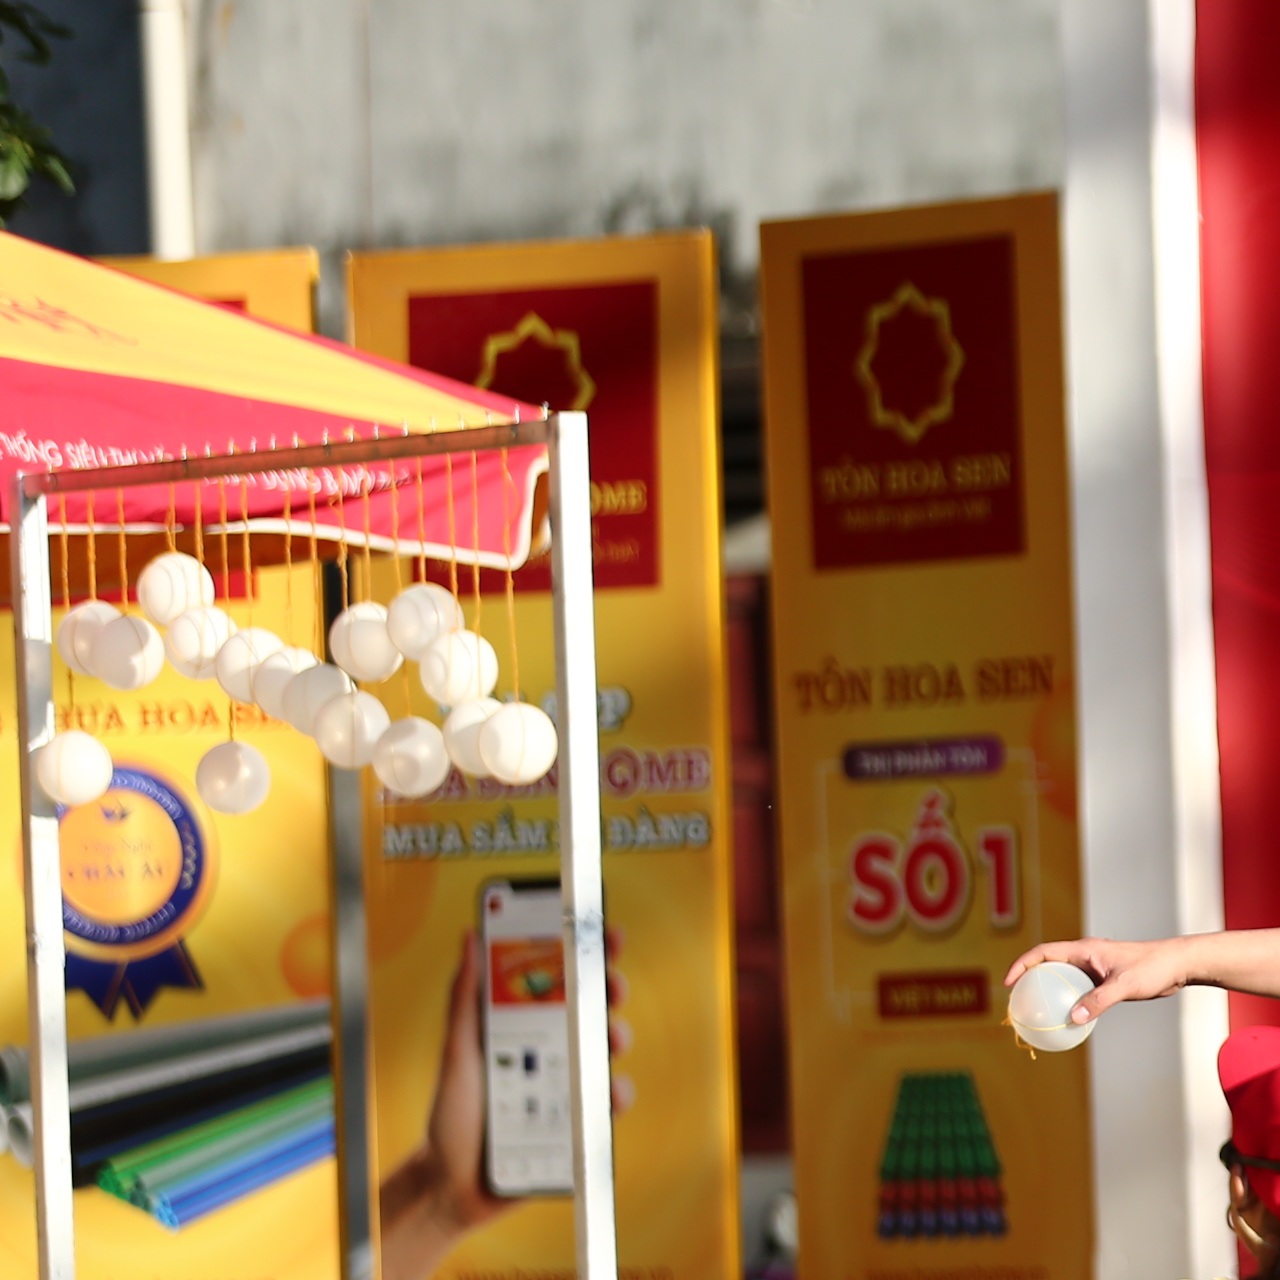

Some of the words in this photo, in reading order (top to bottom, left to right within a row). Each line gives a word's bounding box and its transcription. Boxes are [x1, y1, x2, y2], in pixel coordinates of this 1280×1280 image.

[821, 454, 881, 503] TÔN
[885, 457, 949, 496] HOA
[952, 451, 1012, 492] SEN
[792, 655, 872, 714] TÔN
[881, 661, 966, 709] HOA
[976, 653, 1055, 703] SEN
[138, 698, 221, 732] HOA
[383, 818, 465, 859] MUA
[847, 785, 970, 932] SỐ
[977, 824, 1019, 928] 1
